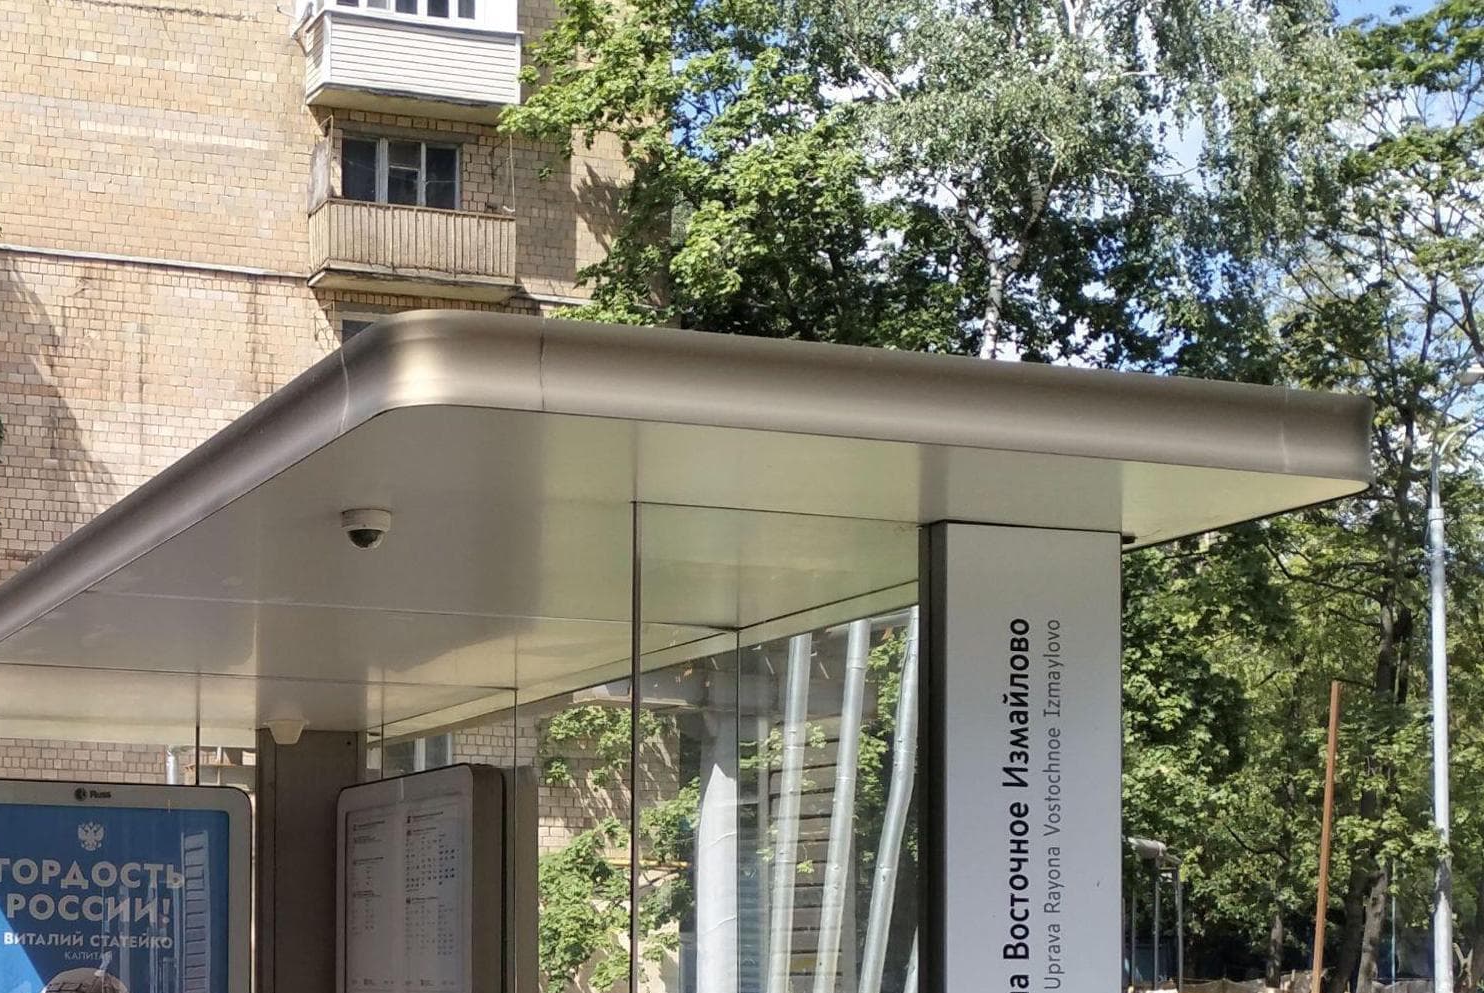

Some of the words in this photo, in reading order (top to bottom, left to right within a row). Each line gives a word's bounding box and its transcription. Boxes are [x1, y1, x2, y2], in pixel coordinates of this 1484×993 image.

[1002, 618, 1030, 788] Измайлово
[1043, 619, 1064, 717] Izmaylovo
[1043, 727, 1061, 836] Vostochnoe
[6, 893, 171, 924] РОССИИ!
[1003, 801, 1030, 960] Восточное
[1043, 846, 1065, 913] Rayona
[4, 931, 84, 946] ВИТАЛИЙ
[90, 932, 173, 949] СТАТЕЙКО
[1044, 923, 1065, 990] Uprava
